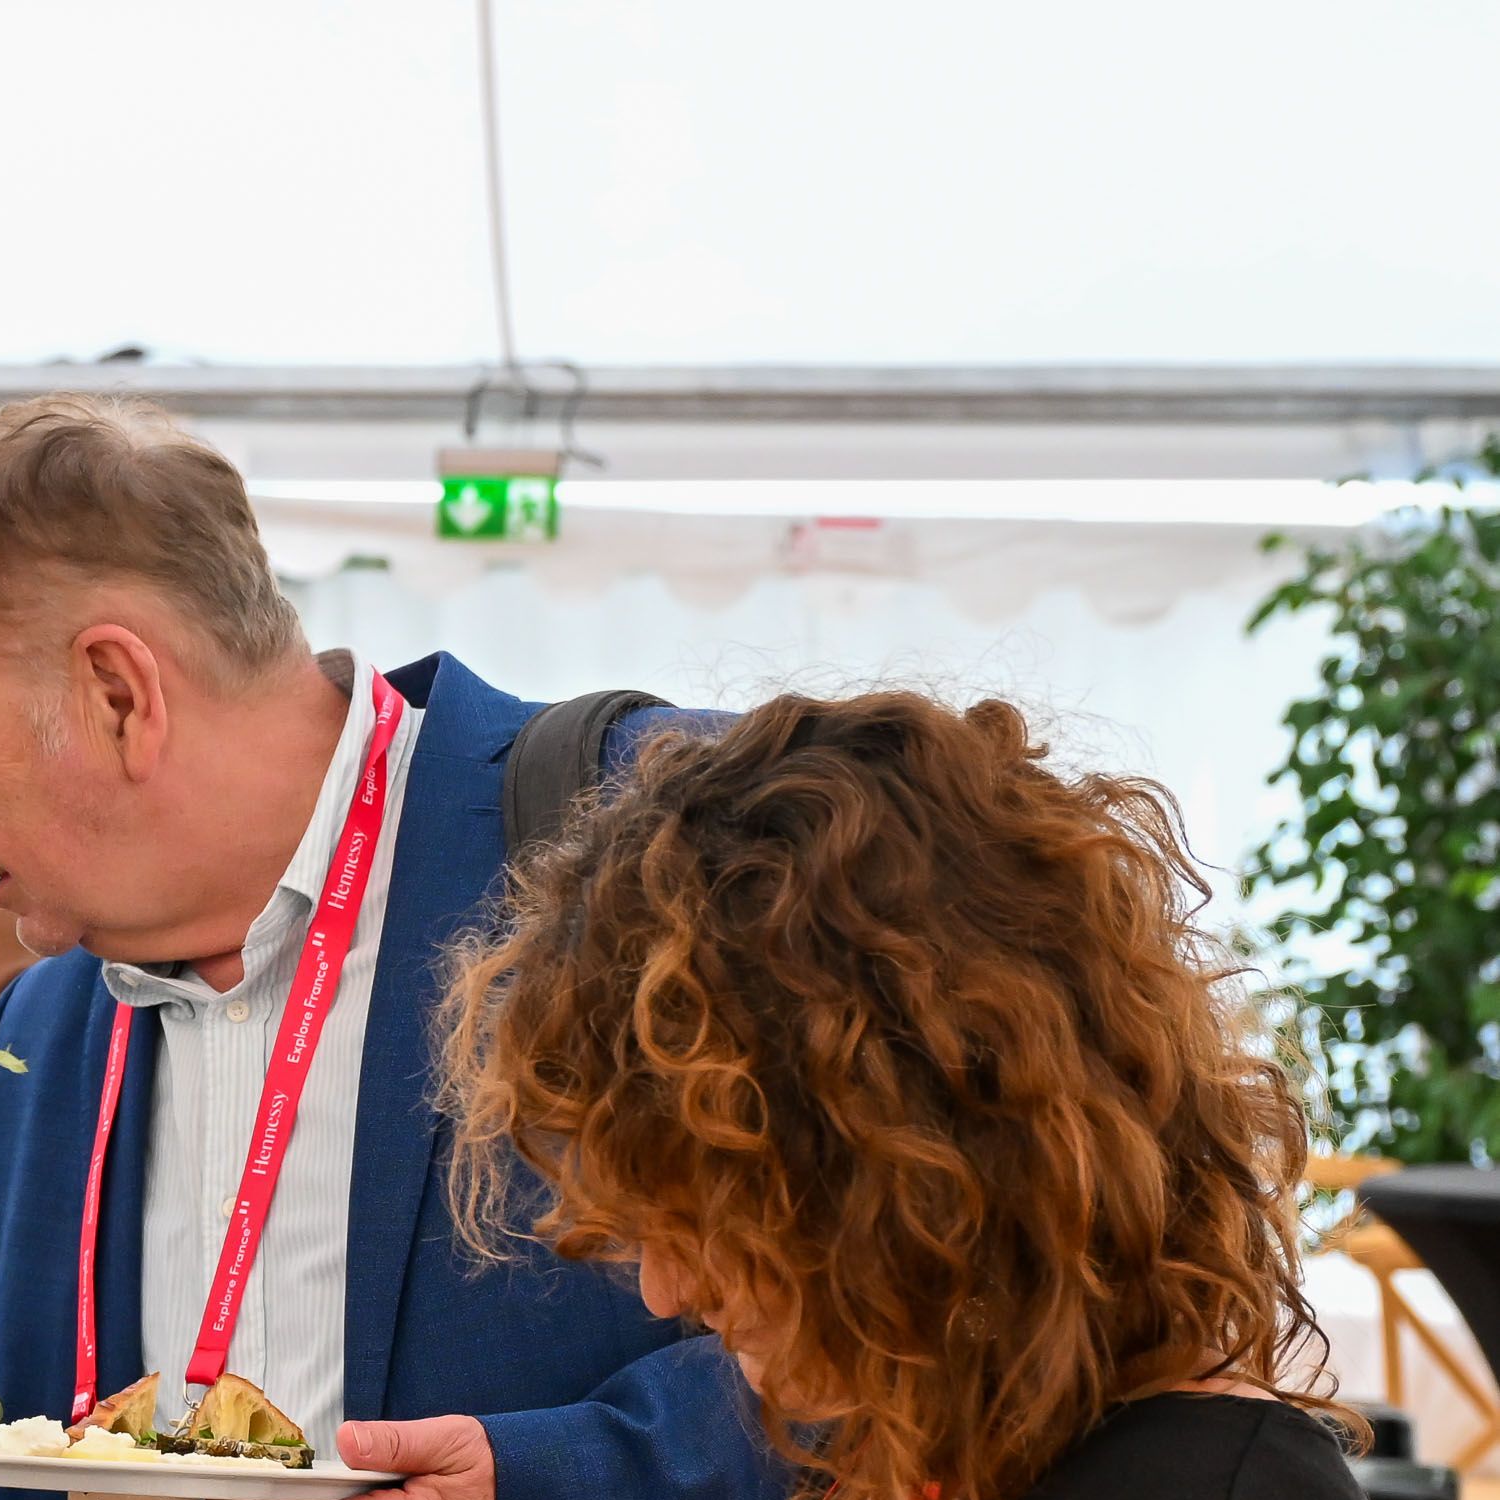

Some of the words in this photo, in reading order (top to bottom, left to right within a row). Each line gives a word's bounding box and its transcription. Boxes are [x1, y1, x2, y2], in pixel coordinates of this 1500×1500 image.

[327, 827, 368, 910] Hennessy
[252, 1088, 289, 1176] Hennessy
[287, 1010, 313, 1064] Explore
[212, 1279, 237, 1332] Explore
